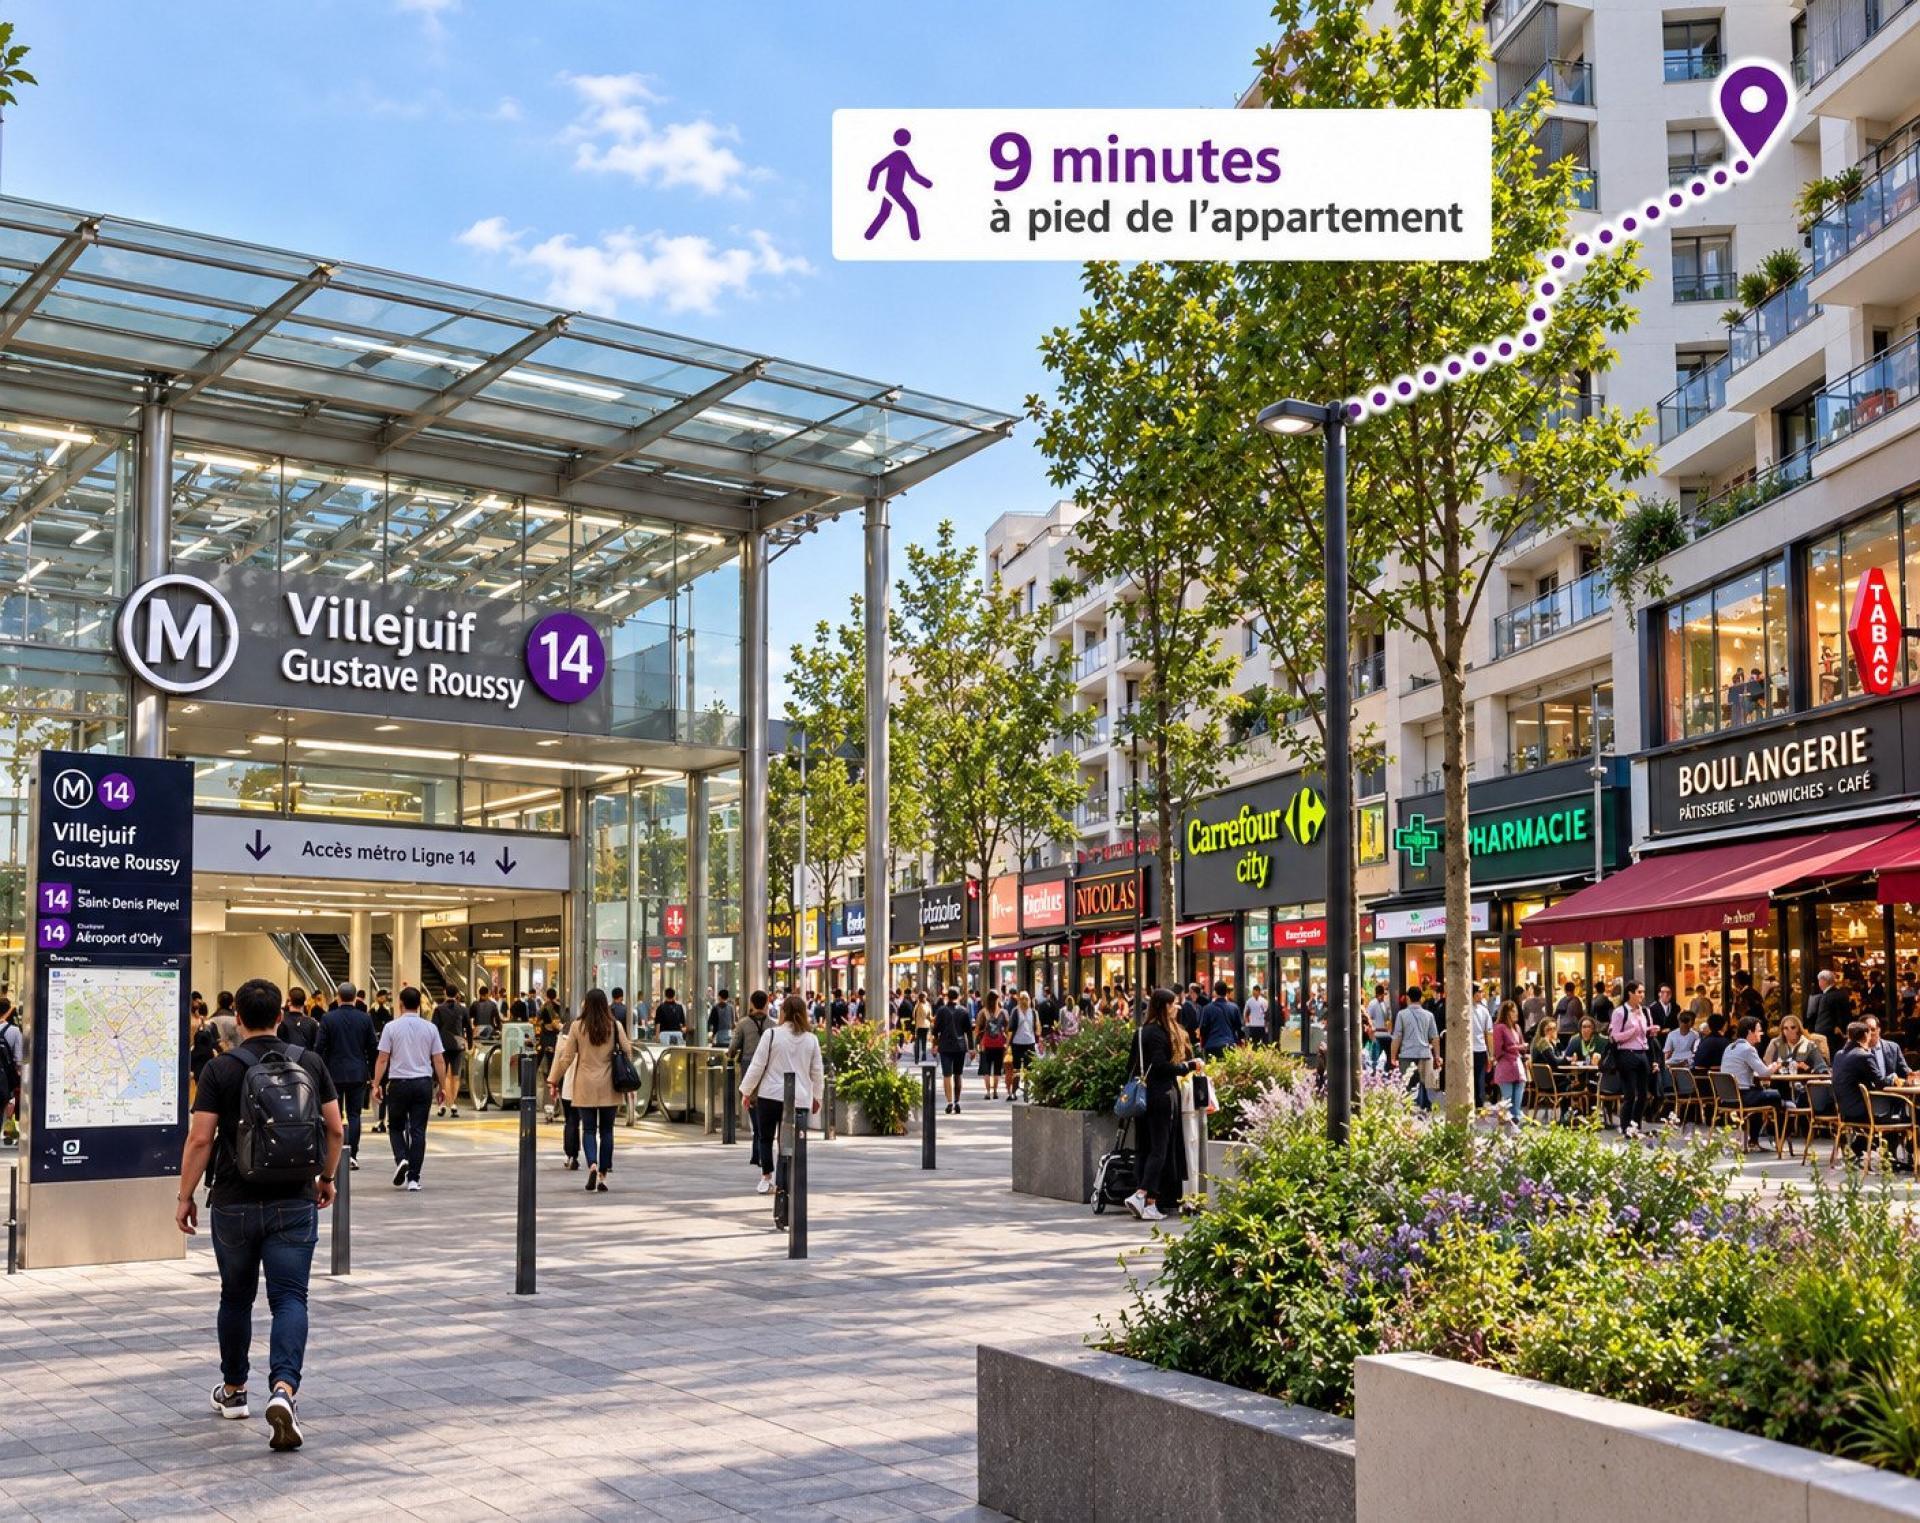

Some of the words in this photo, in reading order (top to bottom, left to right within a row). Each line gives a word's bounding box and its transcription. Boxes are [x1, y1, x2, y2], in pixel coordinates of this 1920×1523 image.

[286, 592, 477, 657] Villejuif
[1869, 583, 1890, 686] TABAC
[540, 631, 593, 684] 14
[281, 649, 418, 693] Gustave
[427, 663, 525, 709] Roussy
[1679, 727, 1868, 797] BOULANGERIE
[62, 778, 85, 800] M
[102, 781, 130, 803] 14
[1747, 782, 1824, 809] SANDWICHES
[1837, 770, 1871, 794] CAFÉ
[52, 822, 137, 847] Villejuif
[1188, 805, 1281, 855] Carrefour
[51, 850, 121, 870] Gustave
[124, 854, 181, 875] Roussy
[301, 840, 352, 859] Accès
[357, 845, 407, 861] métro
[412, 848, 455, 867] Ligne
[458, 851, 476, 866] 14
[1236, 851, 1269, 889] city
[44, 888, 69, 909] 14
[78, 896, 144, 910] Saint-Denis
[146, 899, 180, 912] Pleyel
[1077, 880, 1136, 916] NICOLAS
[44, 924, 65, 942] 14
[76, 930, 127, 946] Aéroport
[129, 932, 163, 947] d'Orly
